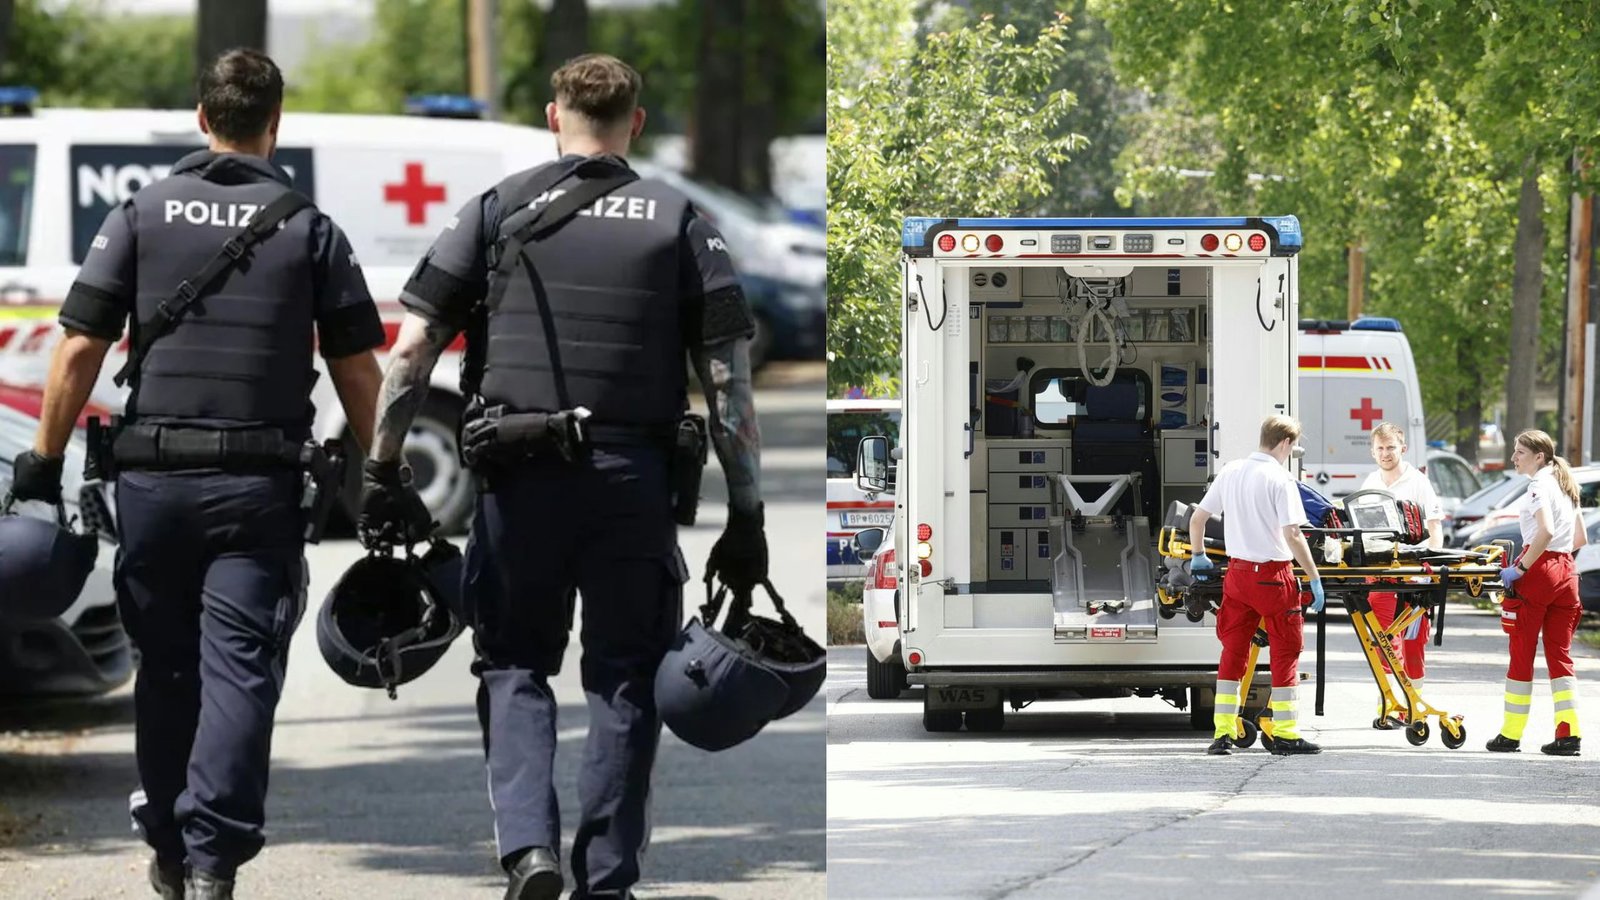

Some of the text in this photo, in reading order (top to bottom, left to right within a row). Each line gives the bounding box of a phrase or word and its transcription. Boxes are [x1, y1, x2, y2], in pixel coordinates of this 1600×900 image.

[165, 199, 286, 229] POLIZ
[528, 188, 656, 220] IZEI
[850, 514, 861, 524] BP
[1377, 630, 1397, 660] stryker
[939, 689, 985, 703] WAS
